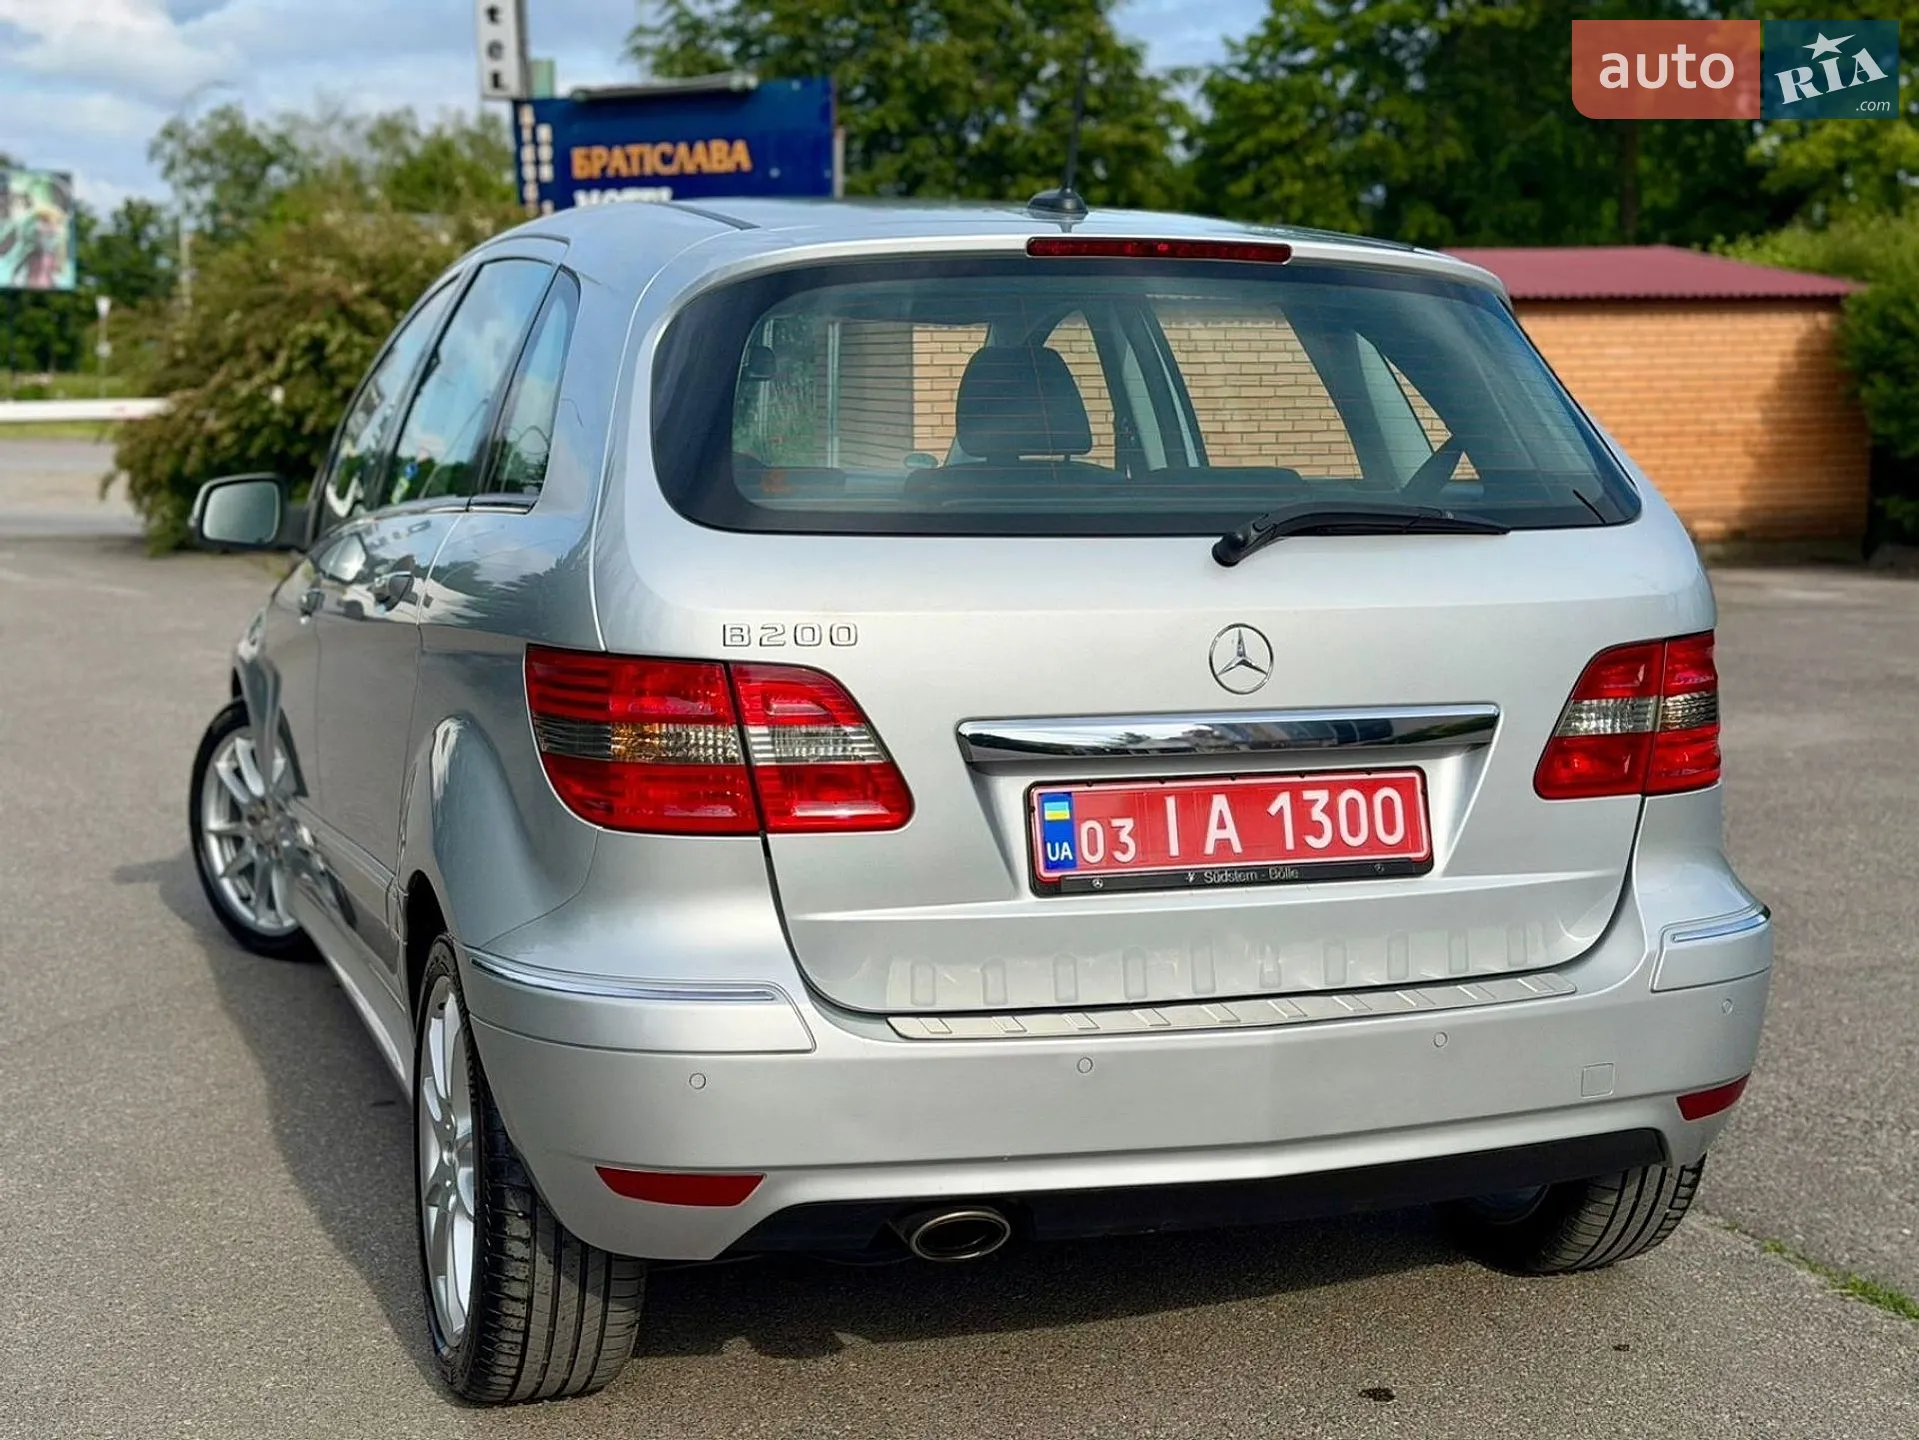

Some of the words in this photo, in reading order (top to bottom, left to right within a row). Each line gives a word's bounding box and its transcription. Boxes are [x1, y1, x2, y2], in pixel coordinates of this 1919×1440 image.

[570, 139, 753, 181] БРАТІСЛАВА
[722, 623, 858, 648] B200
[1080, 816, 1137, 865] 03
[1266, 786, 1405, 851] 1300
[1046, 841, 1074, 862] UA
